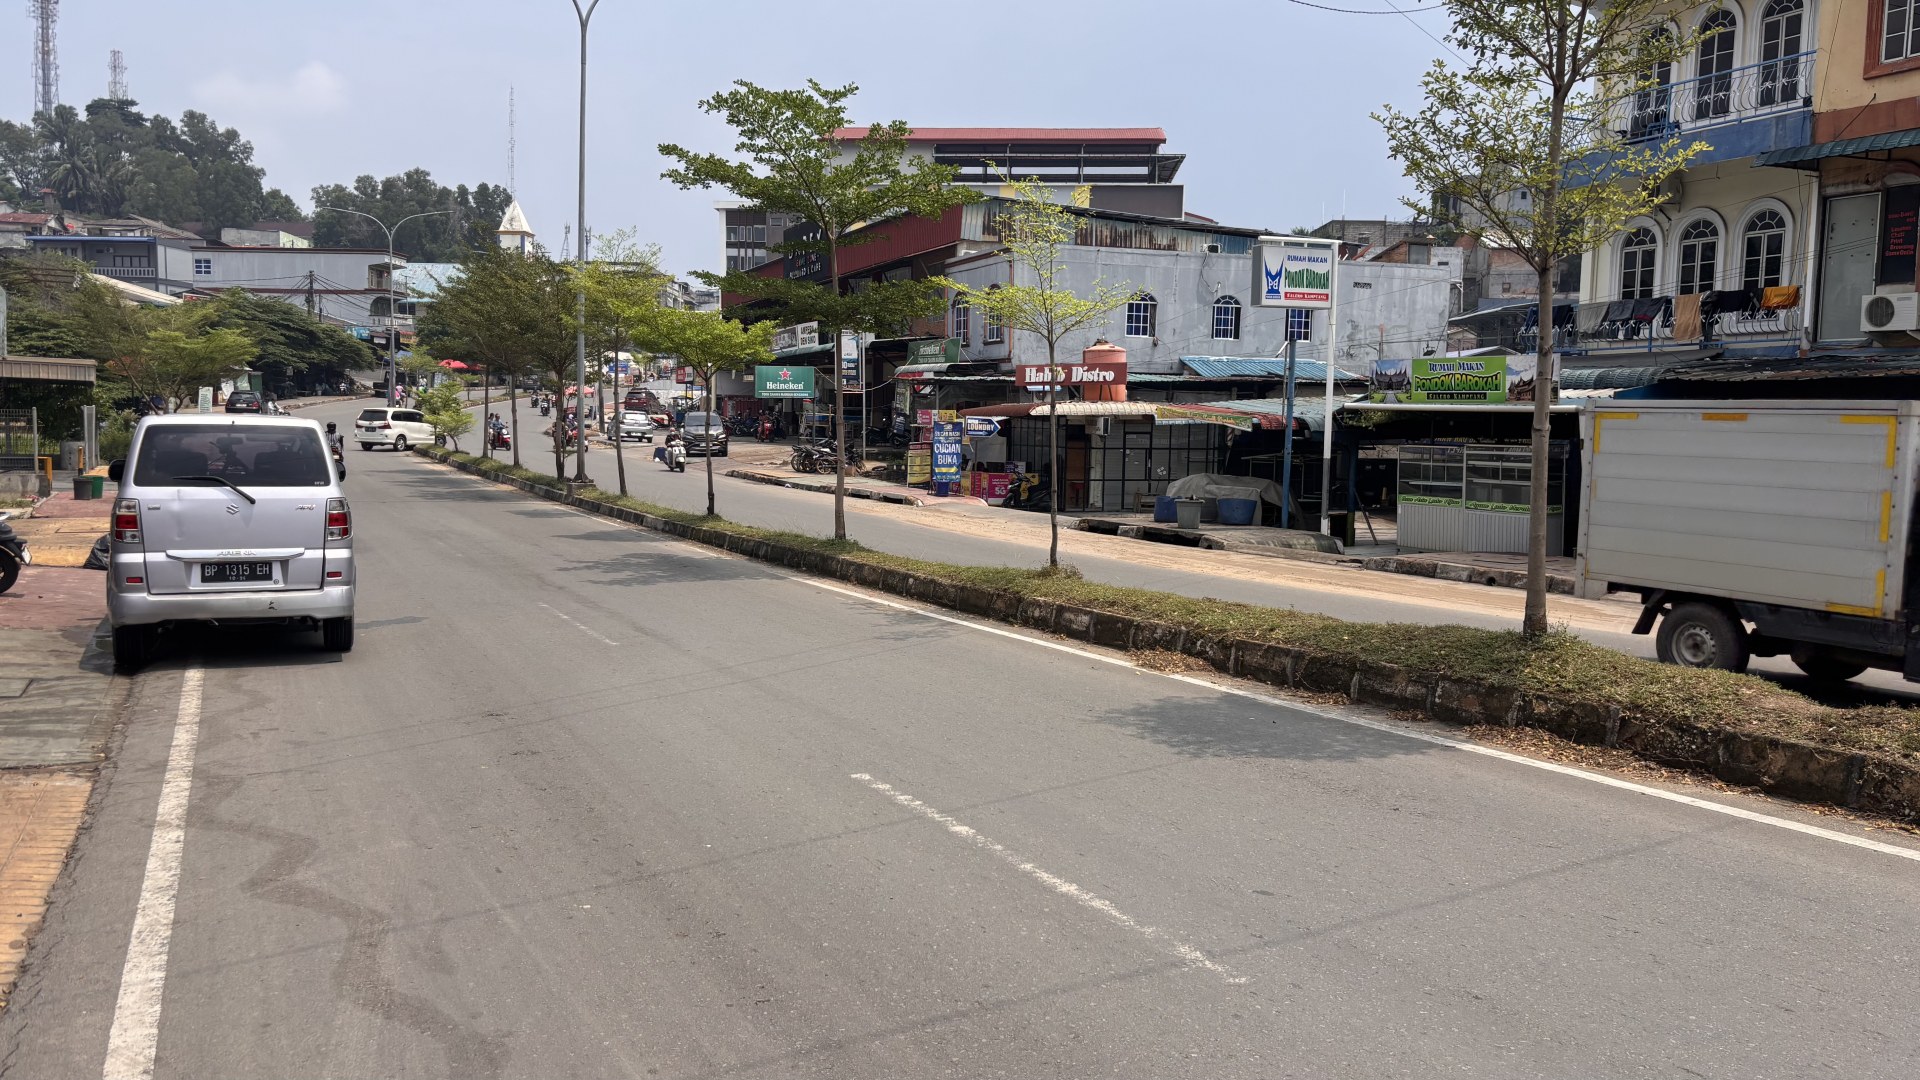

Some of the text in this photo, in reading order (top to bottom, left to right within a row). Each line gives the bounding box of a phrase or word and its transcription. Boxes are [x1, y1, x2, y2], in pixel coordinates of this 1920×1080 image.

[1287, 255, 1328, 264] RUMAH MAKAN
[1284, 266, 1330, 290] PONDOK BAROKAH
[1428, 361, 1484, 372] RUMAH MAKAN
[1071, 366, 1115, 382] Distro
[766, 382, 804, 390] Heineken
[1414, 371, 1501, 392] PONDOK BAROKAH
[934, 443, 960, 454] CUCIAN
[937, 454, 958, 465] BUKA
[994, 486, 1006, 495] 5G
[204, 564, 270, 576] BP 1315 EH
